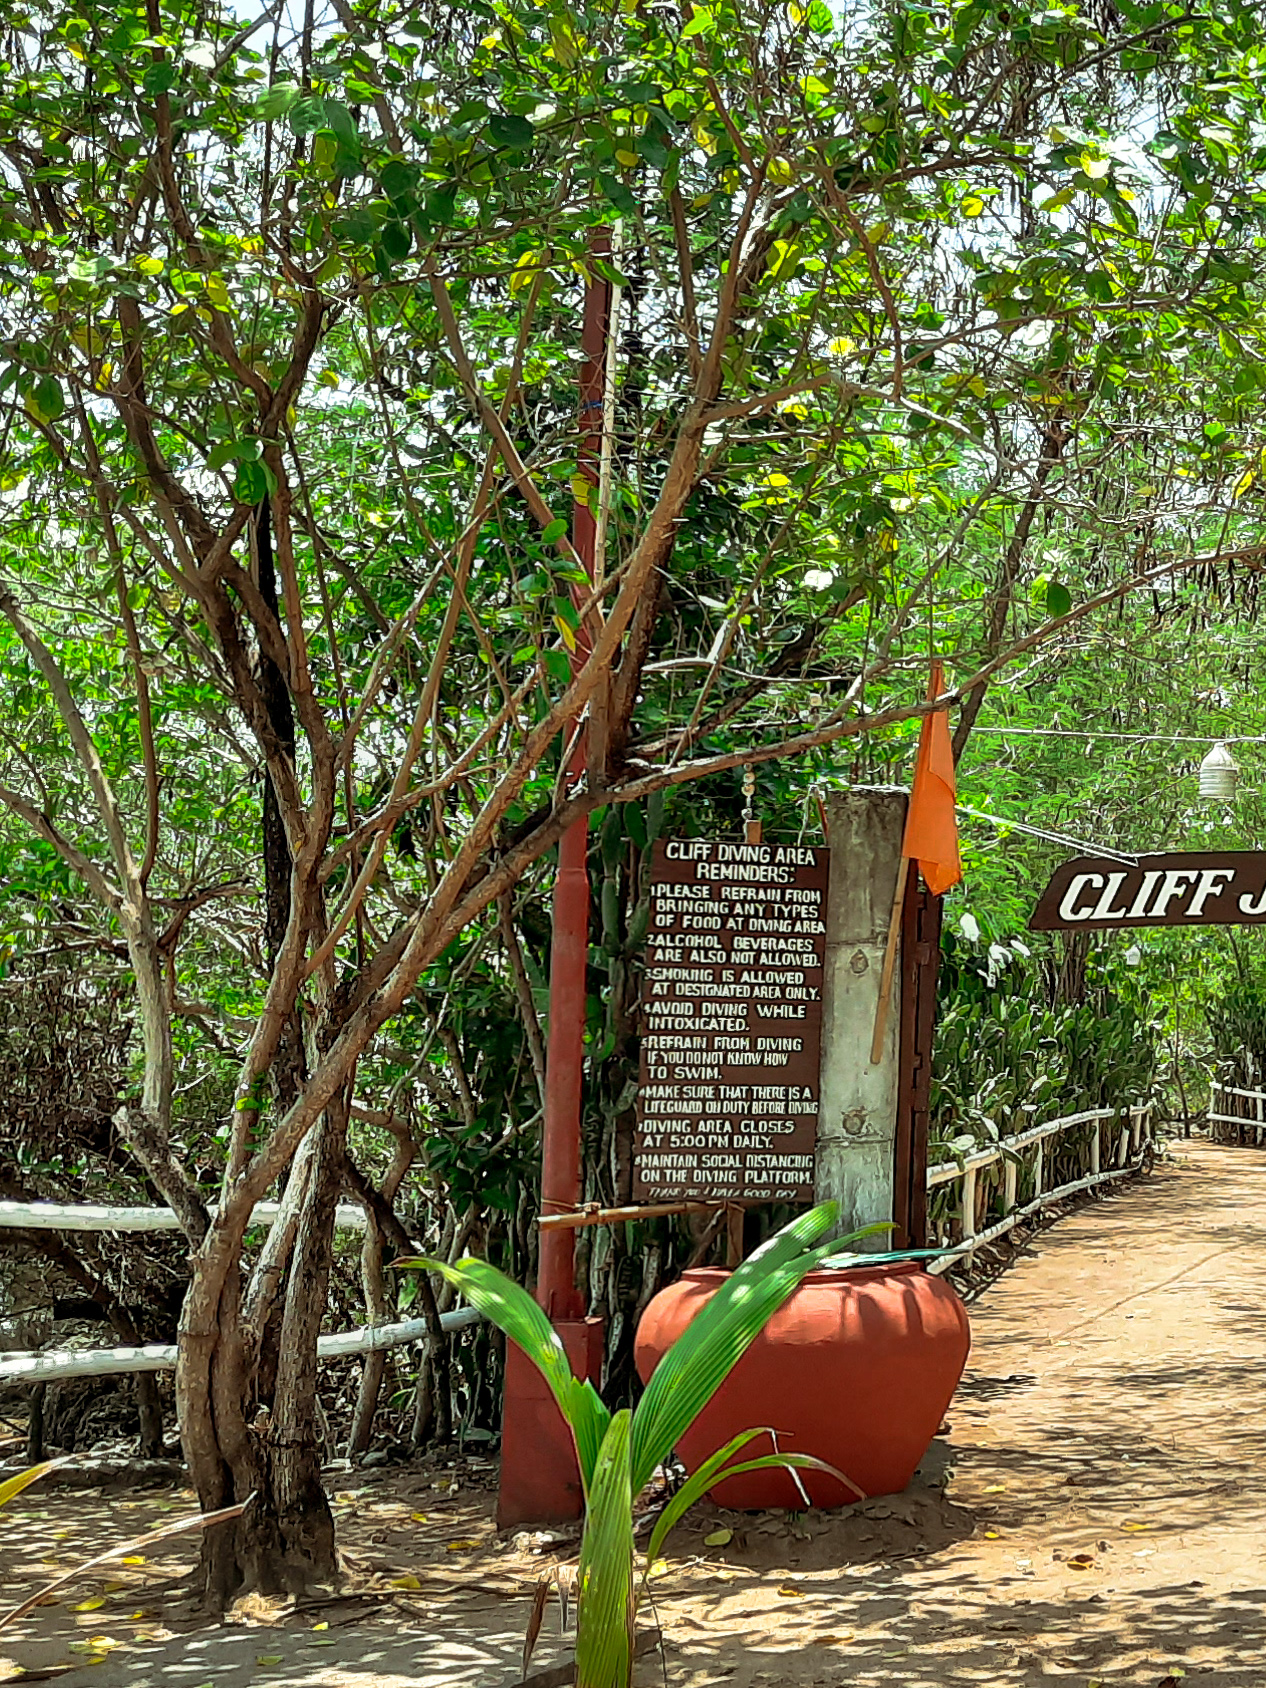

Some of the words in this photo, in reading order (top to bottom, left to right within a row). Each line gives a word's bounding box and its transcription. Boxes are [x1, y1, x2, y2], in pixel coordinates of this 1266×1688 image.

[666, 842, 712, 860] CLIFF
[718, 844, 771, 863] DIVING
[775, 847, 815, 866] AREA
[721, 886, 780, 901] REFRAIN
[785, 889, 821, 904] FROM
[1058, 868, 1235, 921] CLIFF
[656, 899, 729, 914] BRINGING
[733, 903, 766, 917] ANY
[771, 903, 818, 918] TYPES
[656, 914, 675, 926] OF
[682, 915, 721, 929] FOOD
[726, 917, 744, 930] AT
[749, 918, 791, 932] DIVING
[794, 920, 826, 934] AREA
[733, 936, 814, 952] BEVERAGES
[654, 948, 682, 962] ARE
[690, 949, 726, 963] ALSO
[731, 951, 756, 965] NOT
[760, 952, 821, 967] ALLOWED.
[722, 970, 735, 982] IS
[740, 971, 804, 985] ALLOWED
[652, 982, 670, 995] AT
[675, 983, 750, 997] DESIGNATED
[752, 986, 781, 999] AREA
[786, 987, 821, 1000] ONLY.
[702, 1003, 747, 1016] DIVING
[757, 1005, 806, 1018] WHILE
[649, 1017, 750, 1031] INTOXICATED.
[714, 1037, 750, 1050] FROM
[757, 1038, 802, 1051] DIVING
[648, 1051, 658, 1064] IF
[660, 1051, 684, 1064] YOU
[686, 1052, 700, 1064] DO
[702, 1052, 724, 1065] NOT
[727, 1052, 762, 1066] KNOW
[763, 1052, 788, 1066] HOW
[647, 1066, 667, 1079] TO
[674, 1066, 722, 1079] SWIM.
[682, 1086, 715, 1099] SURE
[719, 1086, 749, 1099] THAT
[751, 1086, 785, 1099] THERE
[788, 1086, 800, 1100] IS
[802, 1087, 812, 1099] A
[645, 1100, 702, 1113] LIFEGUARD
[706, 1101, 721, 1113] ON
[723, 1101, 750, 1115] DUTY
[752, 1101, 785, 1114] BEFORE
[697, 1120, 732, 1133] AREA
[741, 1121, 795, 1133] CLOSES
[643, 1135, 663, 1147] AT
[670, 1135, 705, 1147] 5:00
[709, 1135, 729, 1148] PM
[733, 1136, 774, 1149] DAILY.
[701, 1155, 743, 1167] SOCIAL
[746, 1155, 813, 1168] DISTANCING
[641, 1170, 660, 1182] ON
[664, 1170, 687, 1182] THE
[693, 1170, 737, 1183] DIVING
